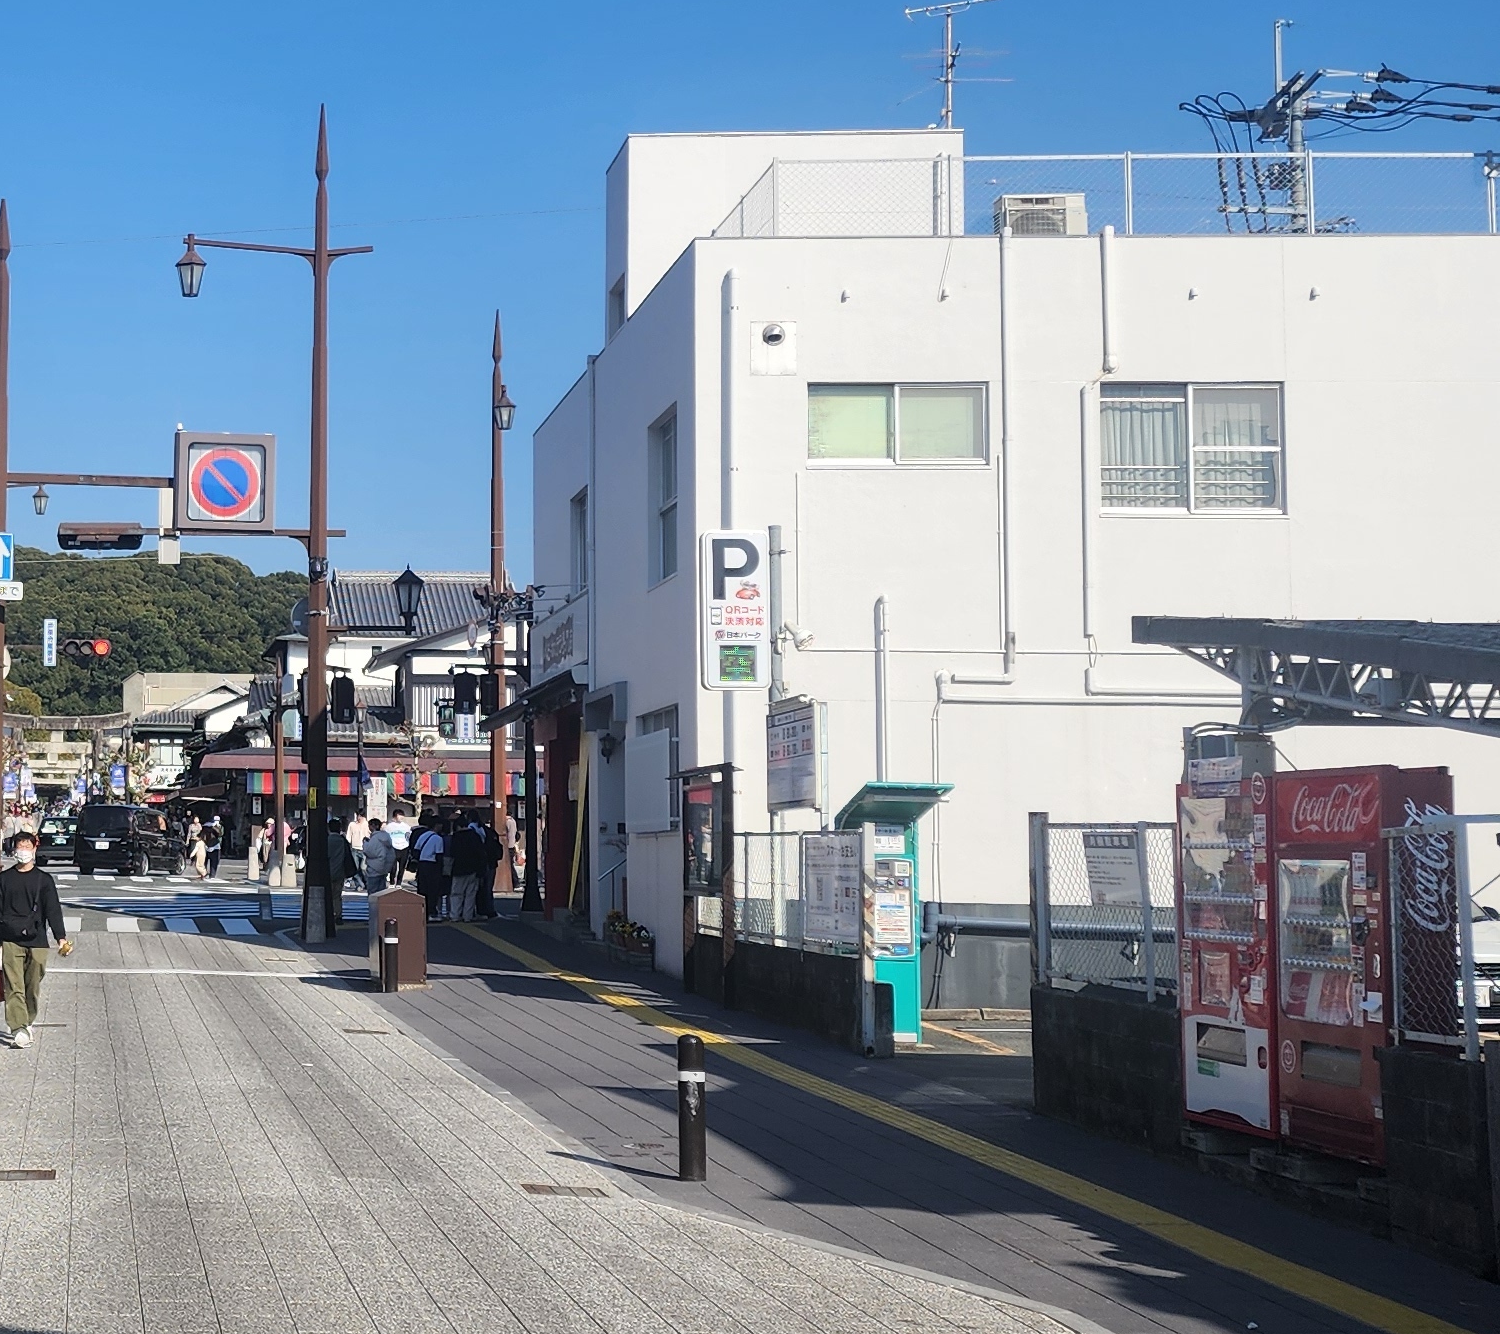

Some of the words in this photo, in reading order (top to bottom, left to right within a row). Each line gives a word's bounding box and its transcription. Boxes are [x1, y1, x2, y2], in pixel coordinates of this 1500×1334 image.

[712, 538, 760, 600] P
[725, 605, 765, 615] QRコード
[725, 616, 765, 626] 決済対応
[726, 631, 762, 639] 日本パーク
[1292, 781, 1379, 835] Coca-Cola
